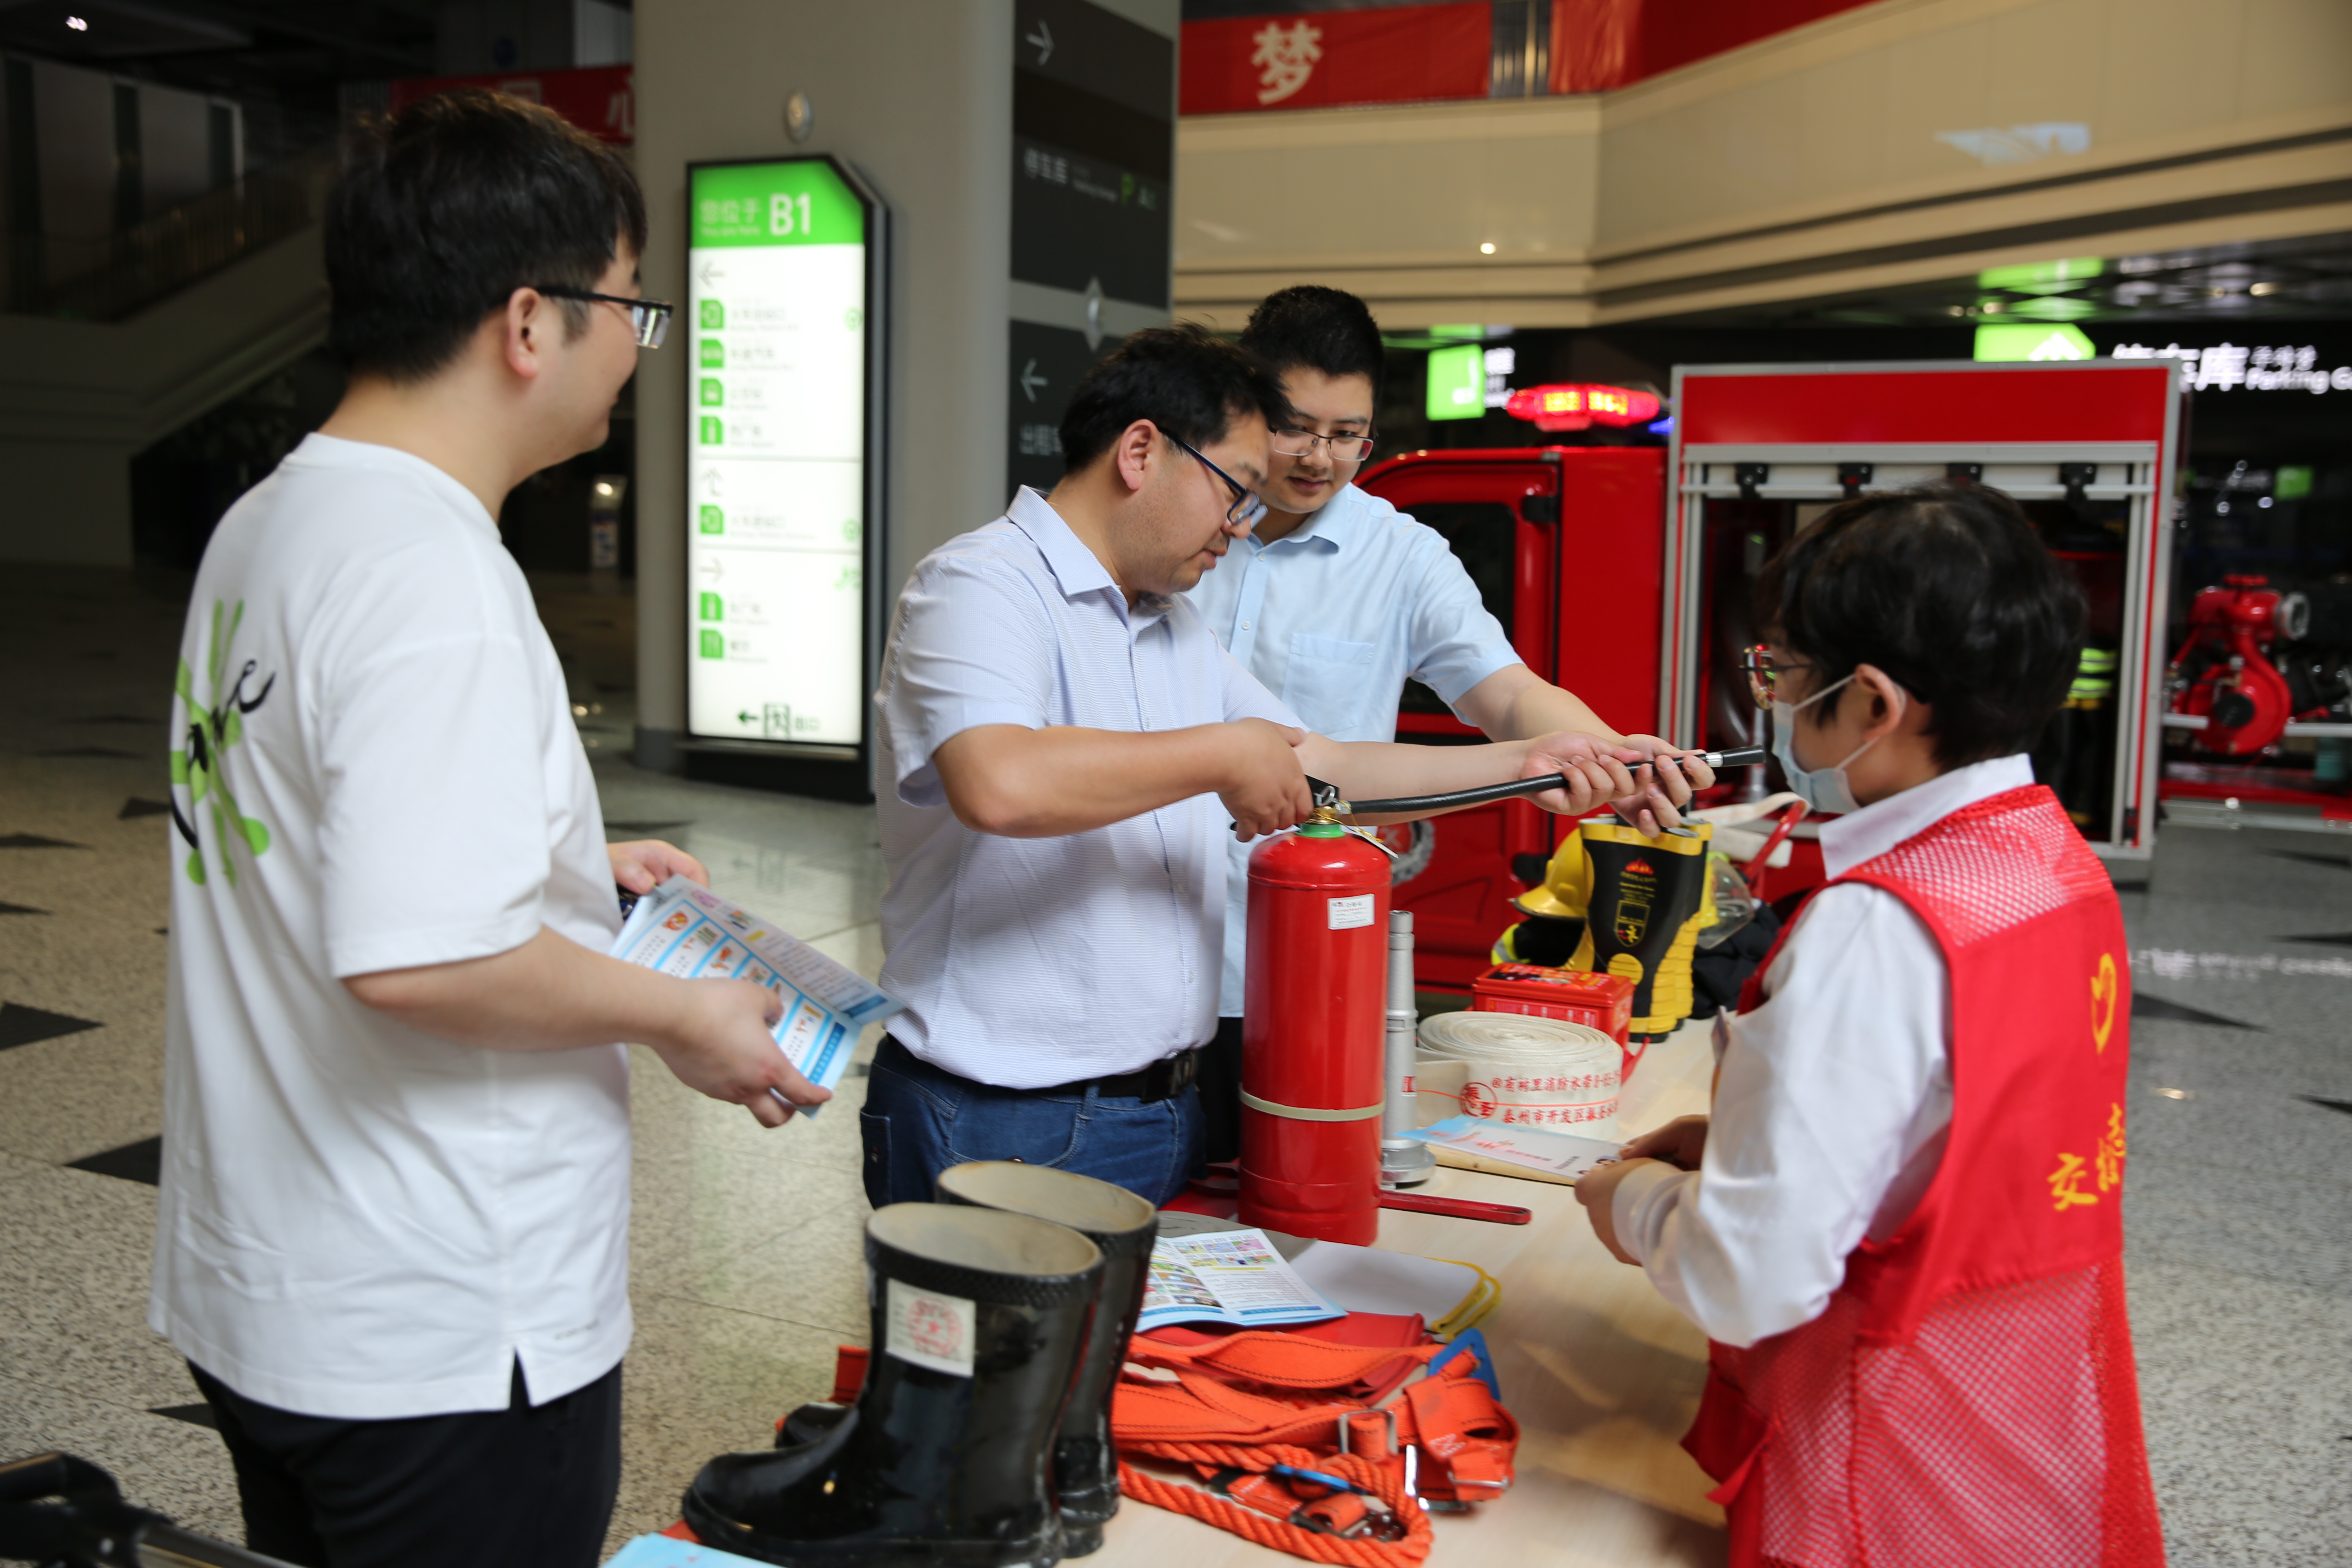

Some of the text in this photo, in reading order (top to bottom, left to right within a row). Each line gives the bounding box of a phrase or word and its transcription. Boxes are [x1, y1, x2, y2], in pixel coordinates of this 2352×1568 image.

[1250, 20, 1323, 105] 梦
[769, 192, 811, 236] B1
[2245, 367, 2330, 394] Parking
